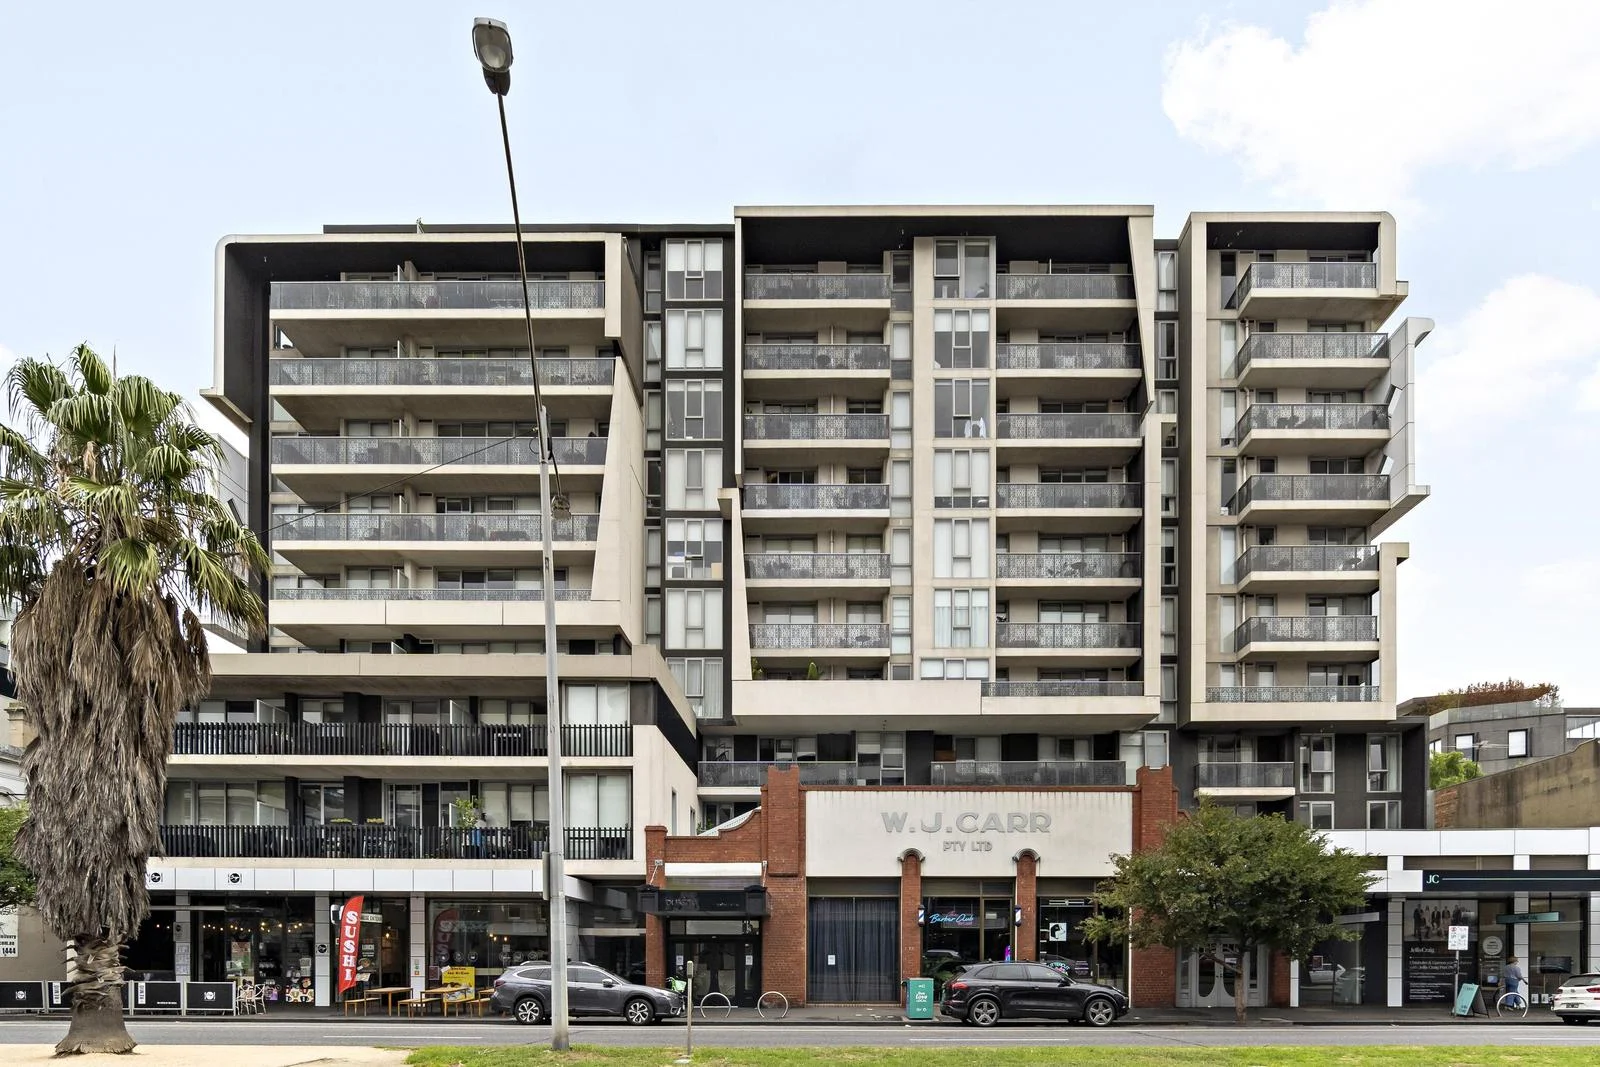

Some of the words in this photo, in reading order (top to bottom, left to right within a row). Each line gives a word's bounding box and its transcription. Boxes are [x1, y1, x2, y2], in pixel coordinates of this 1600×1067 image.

[943, 841, 967, 852] PTY
[971, 841, 993, 852] LTD
[1426, 874, 1440, 884] JC
[929, 913, 956, 924] Barber
[342, 910, 359, 981] SUSHI
